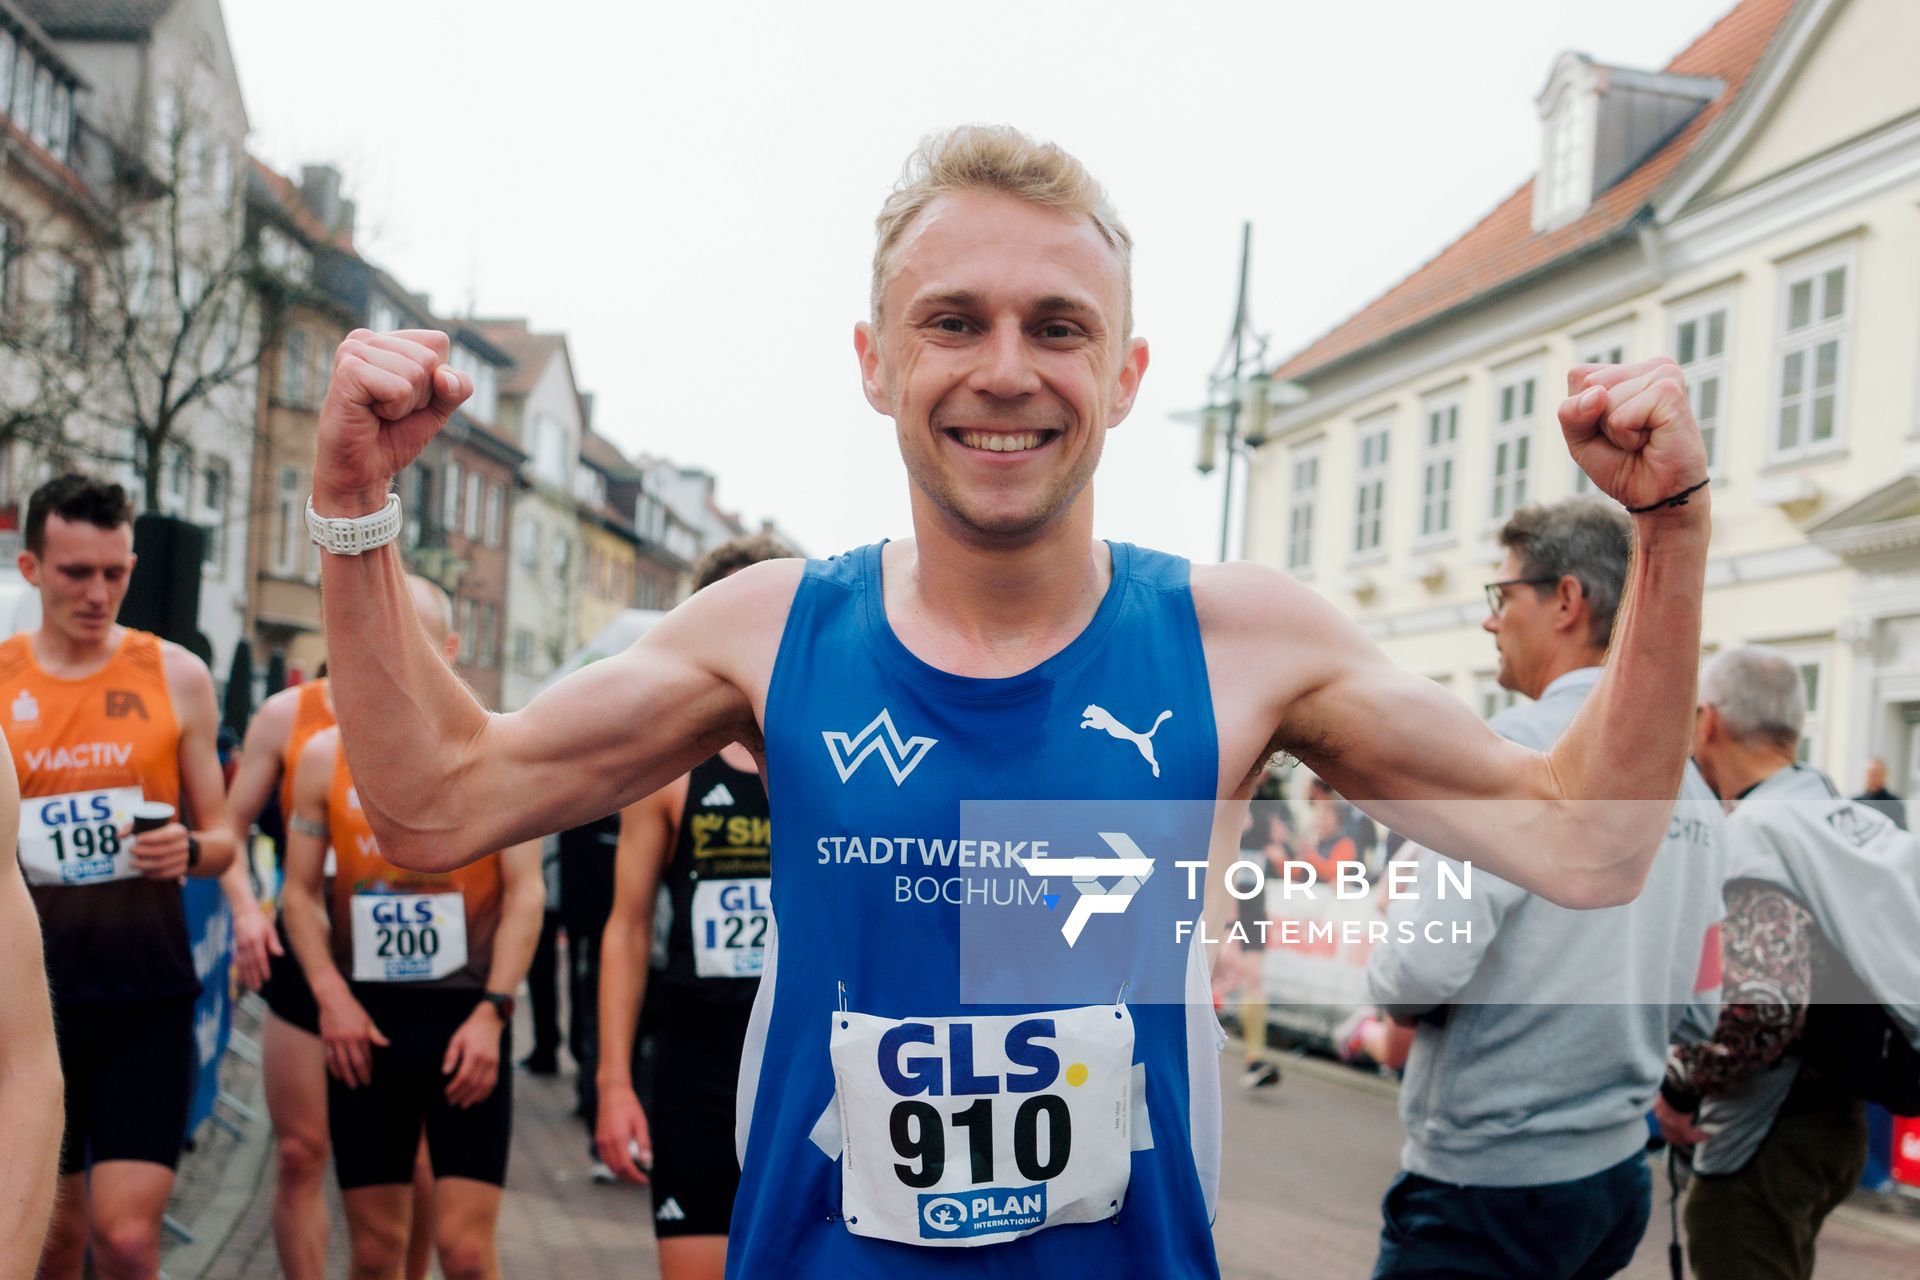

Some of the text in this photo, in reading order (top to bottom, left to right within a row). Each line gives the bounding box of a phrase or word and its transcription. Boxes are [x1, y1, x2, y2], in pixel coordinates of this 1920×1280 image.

[23, 742, 132, 771] VIACTIV
[48, 824, 120, 861] 198
[720, 886, 768, 912] GL
[895, 876, 1049, 906] BOCHUM
[376, 928, 439, 958] 200
[889, 1094, 1072, 1188] 910
[972, 1194, 1041, 1219] PLAN
[973, 1216, 1041, 1230] INTERNATIONAL
